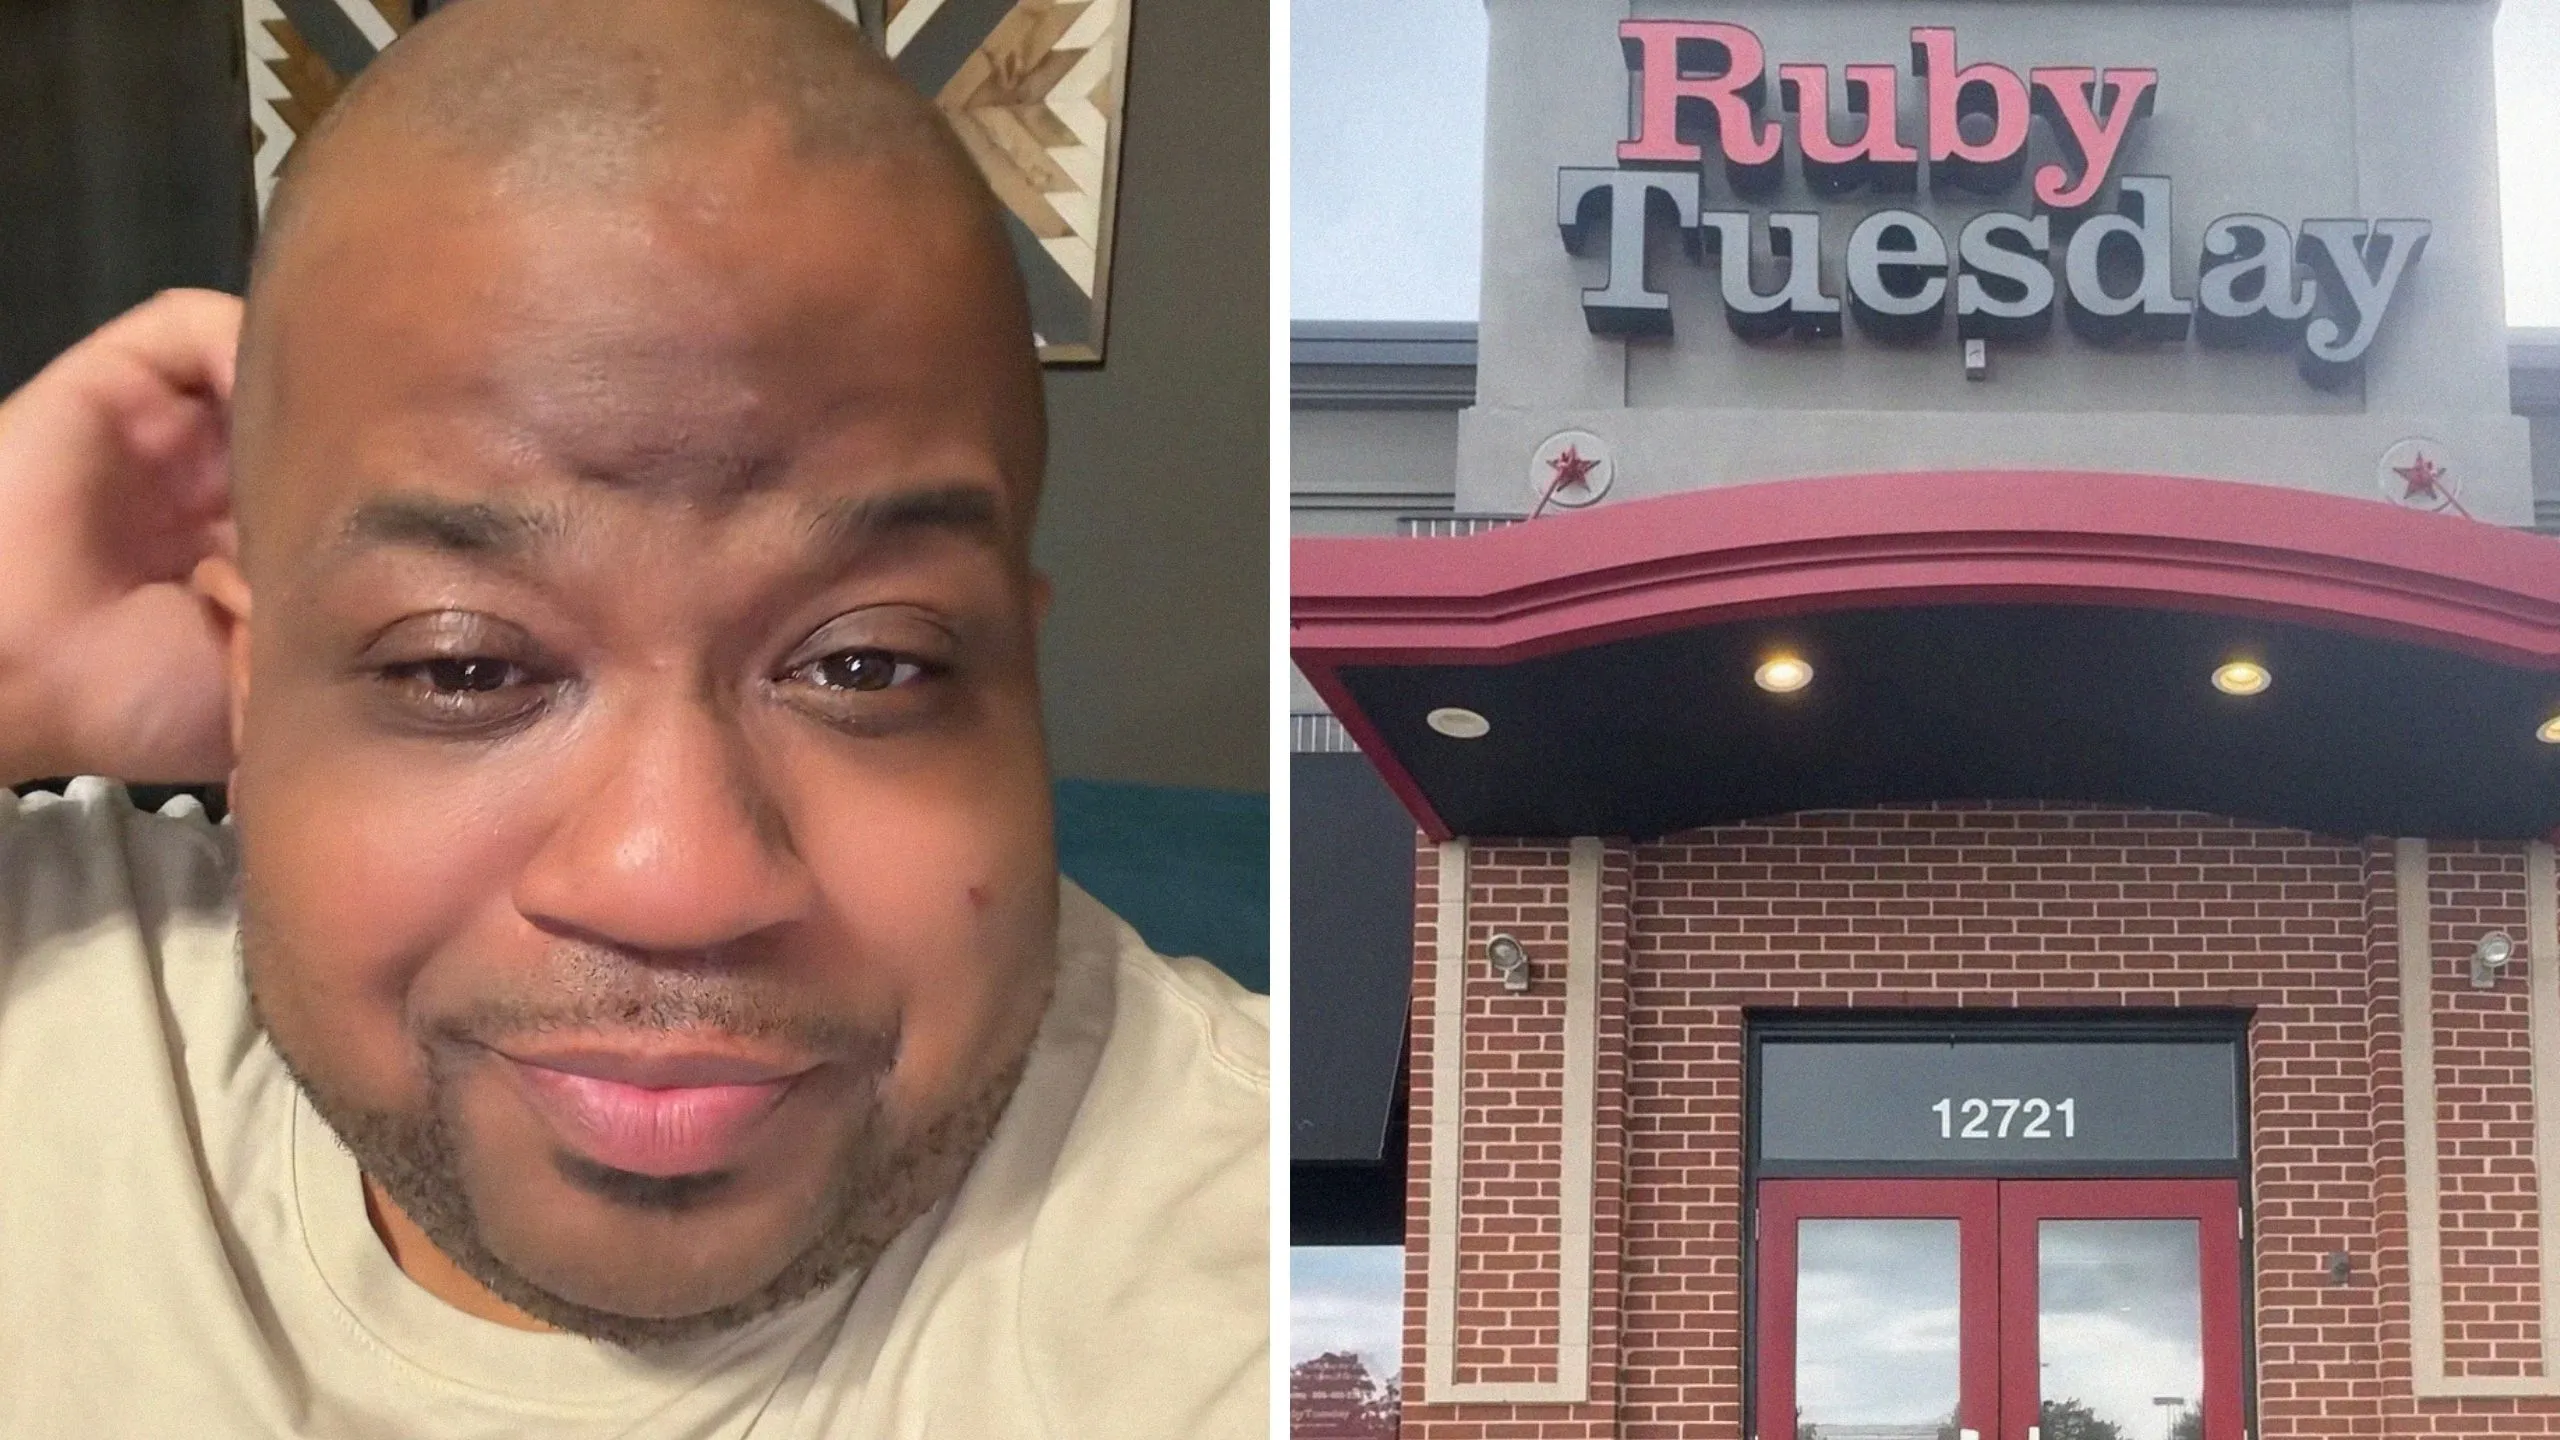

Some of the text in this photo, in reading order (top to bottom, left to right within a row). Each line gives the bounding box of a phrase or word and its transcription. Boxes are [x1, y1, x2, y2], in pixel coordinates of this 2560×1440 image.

[1617, 19, 2158, 208] Ruby
[1557, 166, 2432, 363] Tuesday
[1932, 1098, 2075, 1138] 12721
